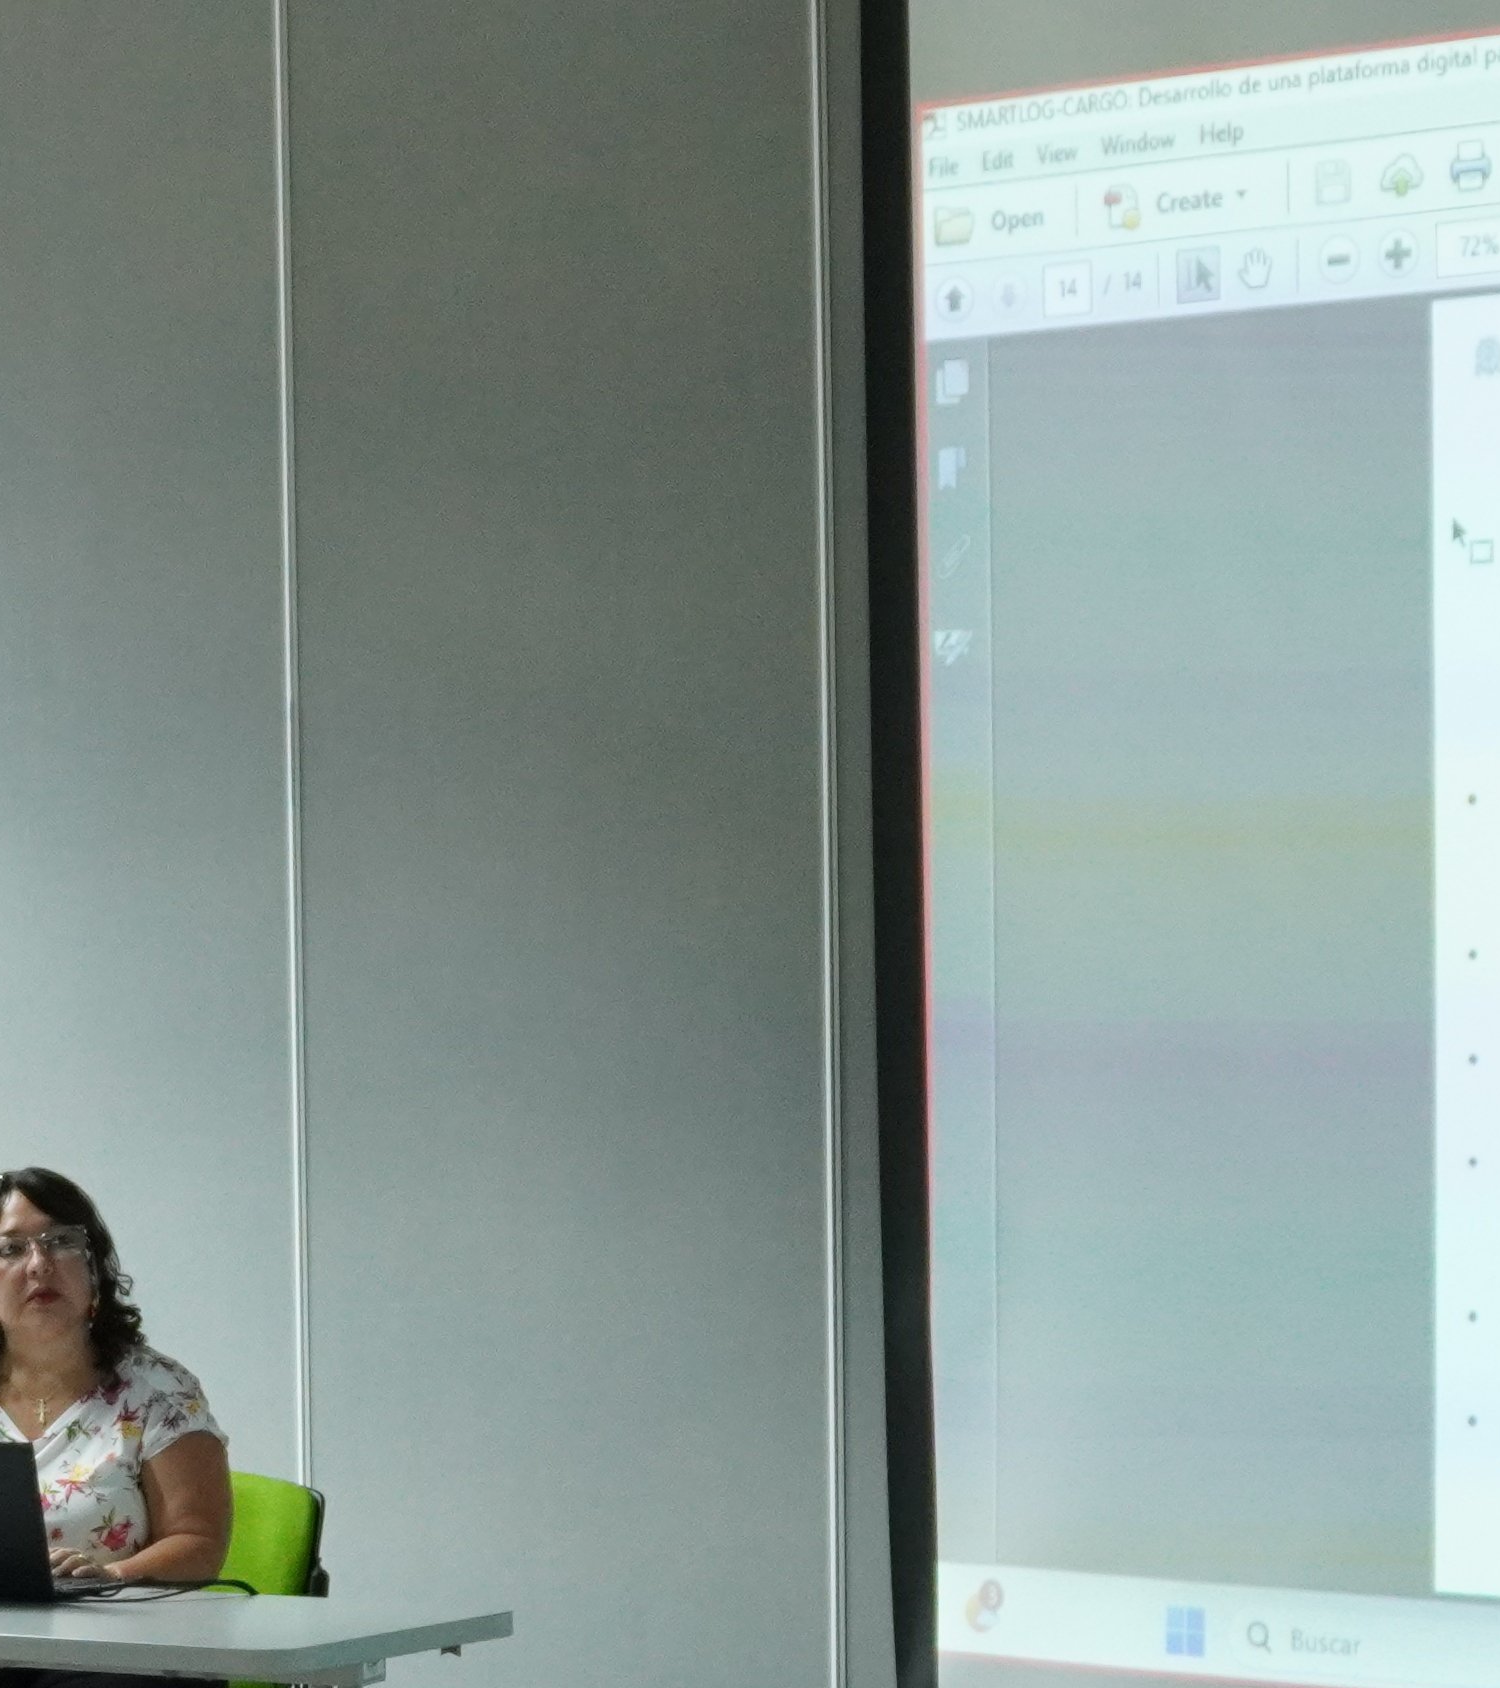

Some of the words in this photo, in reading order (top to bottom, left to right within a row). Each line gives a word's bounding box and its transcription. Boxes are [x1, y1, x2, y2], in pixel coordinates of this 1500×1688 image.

[1138, 80, 1231, 108] Desarrollo
[1239, 75, 1262, 96] de
[1268, 74, 1301, 92] una
[1308, 56, 1409, 87] plataforma
[1417, 45, 1478, 76] digital
[929, 156, 959, 178] File
[982, 149, 1014, 173] Edit
[1037, 143, 1078, 166] View
[1100, 129, 1176, 157] Window
[1199, 122, 1244, 147] Help
[991, 207, 1045, 235] Open
[1156, 190, 1223, 215] Create
[1459, 233, 1500, 259] 72%
[1059, 276, 1078, 299] 14
[1122, 271, 1143, 294] 14
[1291, 1629, 1362, 1657] Buscar
